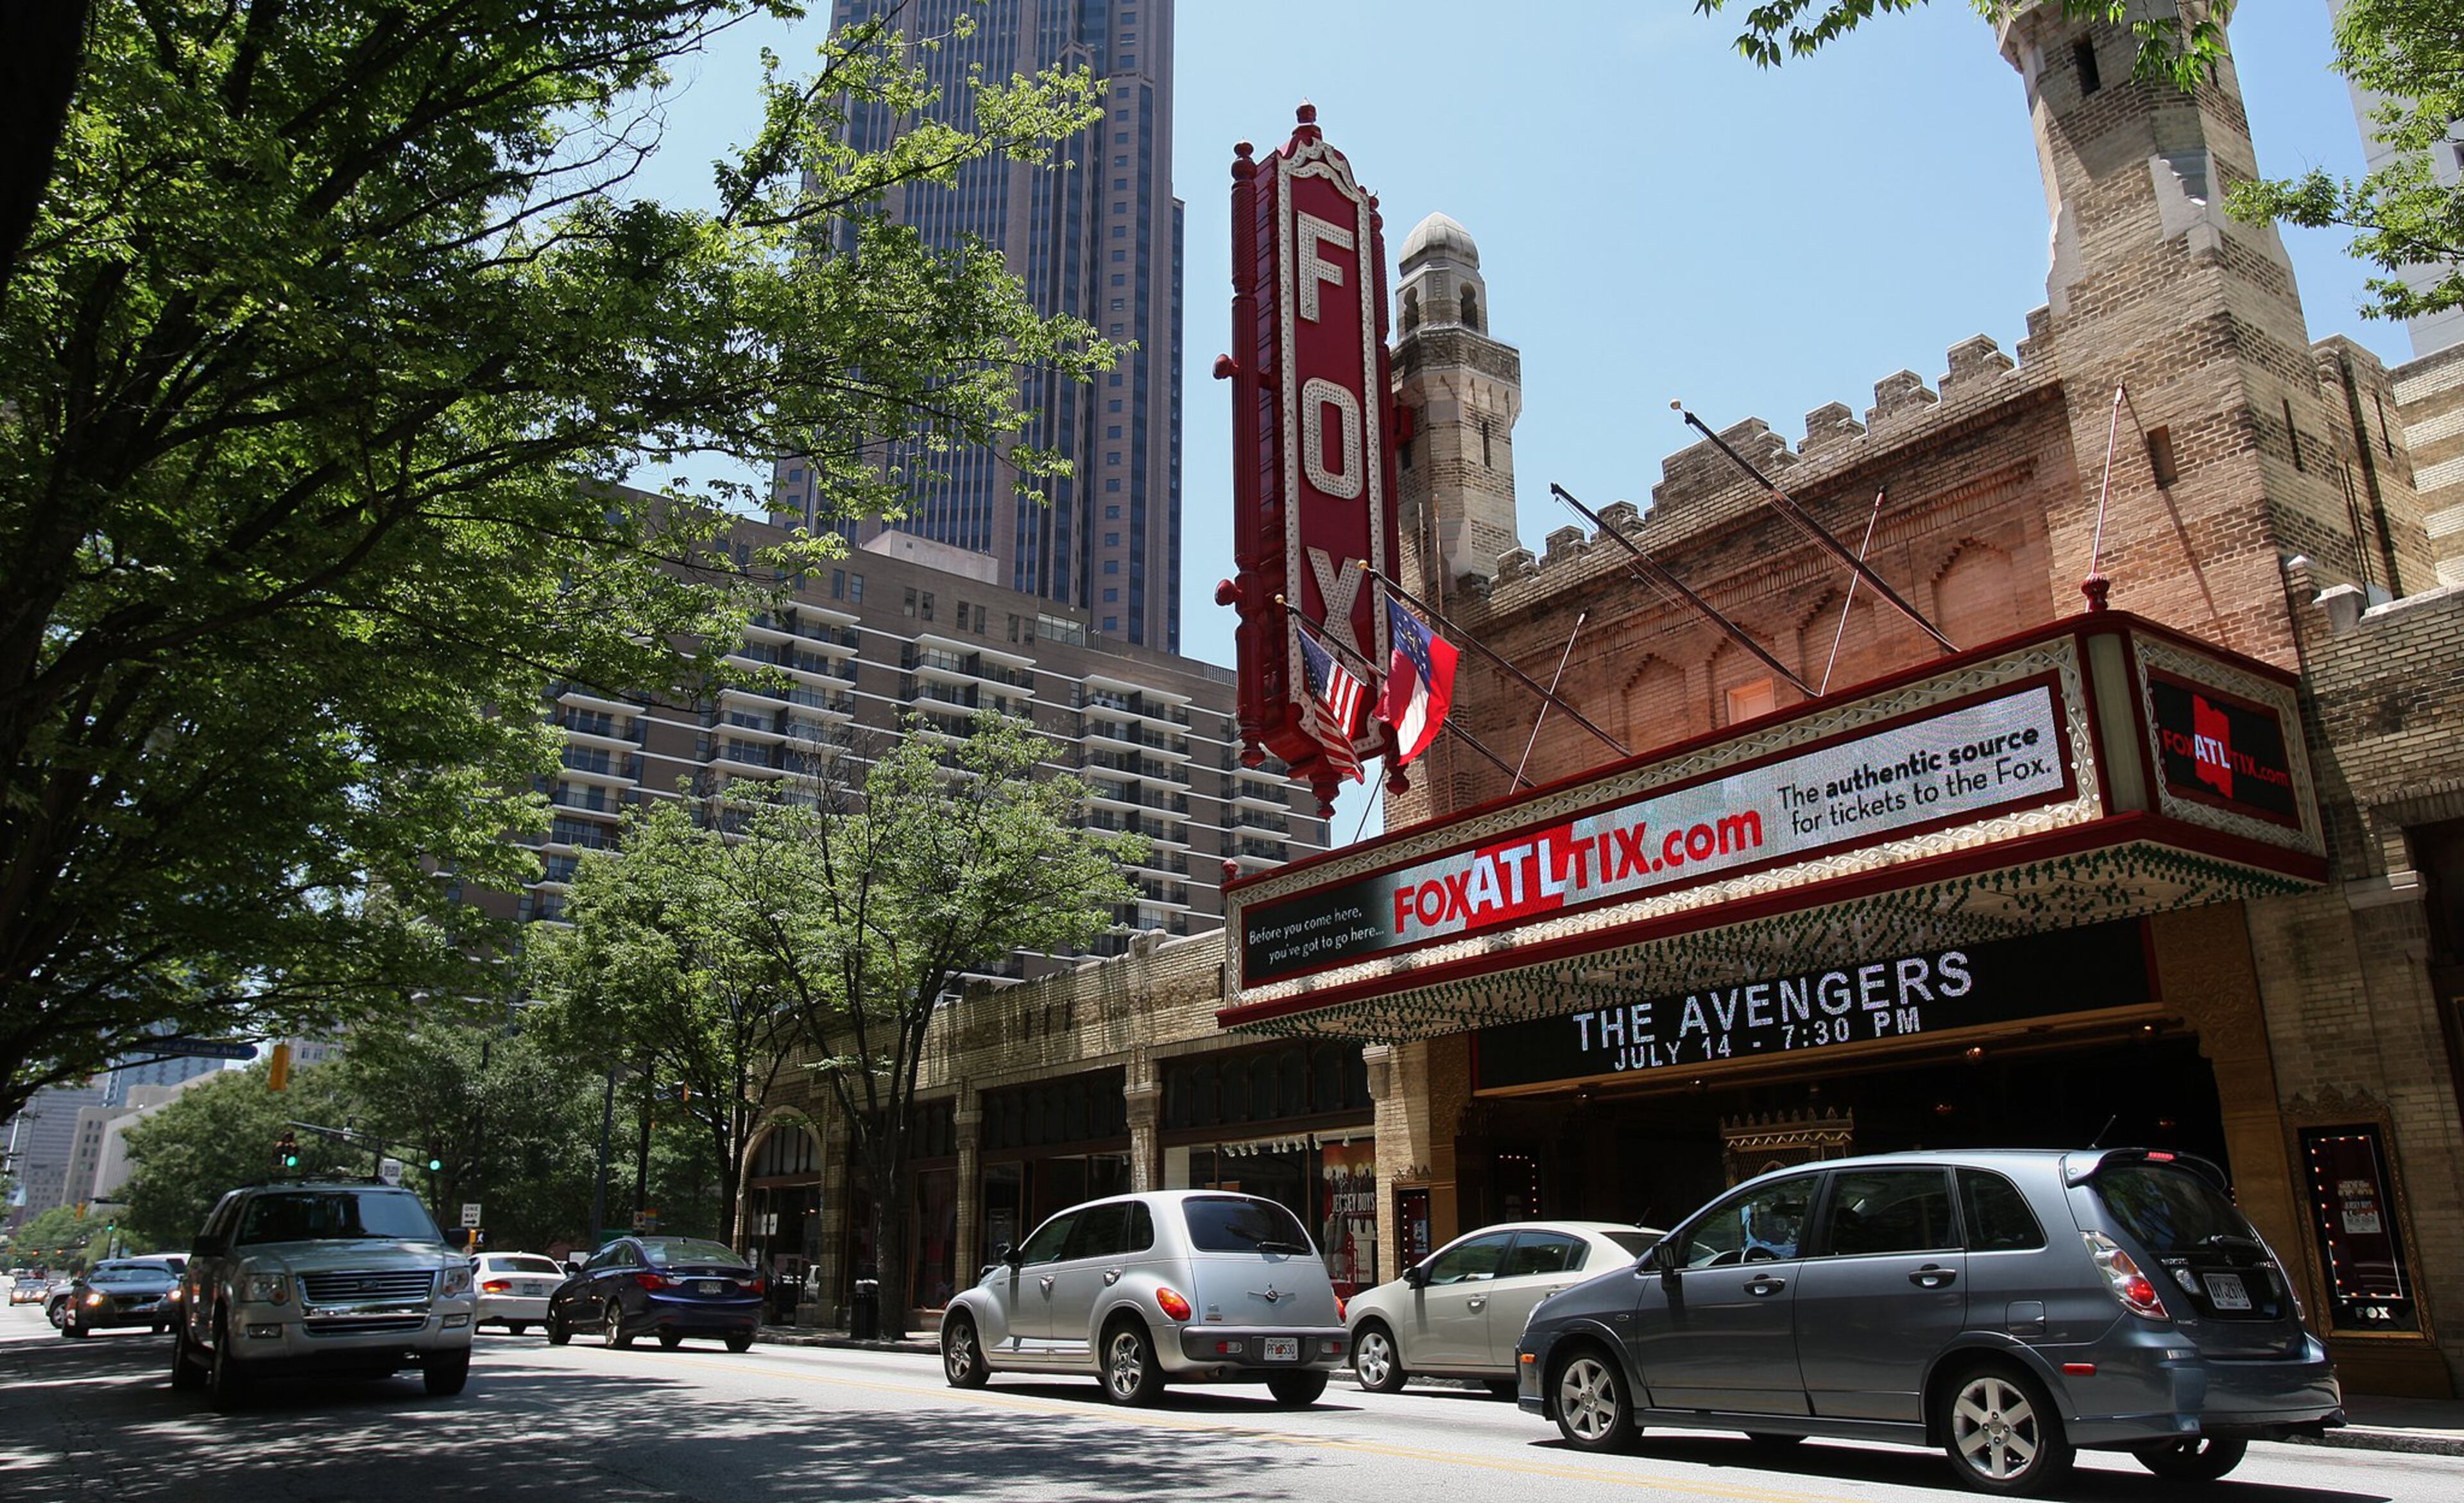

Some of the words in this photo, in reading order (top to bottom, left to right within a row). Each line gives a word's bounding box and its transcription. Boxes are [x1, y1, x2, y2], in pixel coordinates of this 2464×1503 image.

[1297, 210, 1371, 688] FOX
[1777, 784, 1819, 810] The
[1826, 750, 1942, 798] authentic
[1948, 727, 2039, 766] source
[1791, 811, 1823, 836] for
[1829, 791, 1906, 825] tickets
[1913, 782, 1938, 805] to
[1946, 769, 1988, 798] the
[1995, 756, 2052, 785] Fox.
[1249, 927, 1282, 945] Before
[1284, 923, 1302, 940] you
[1304, 914, 1332, 930] come
[1269, 943, 1301, 965] you've
[1303, 938, 1319, 958] got
[1321, 936, 1333, 949] to
[1335, 934, 1348, 950] go
[1351, 927, 1385, 942] here...
[1573, 1003, 1655, 1052] THE
[1680, 951, 1972, 1038] AVENGERS
[1614, 1041, 1681, 1072] JULY
[1701, 1034, 1732, 1060] 14
[1781, 1017, 1850, 1050] 7:30
[1874, 1006, 1921, 1037] PM
[1332, 1193, 1357, 1212] JERSEY
[1357, 1192, 1376, 1212] BOYS
[2356, 1307, 2391, 1319] FOX
